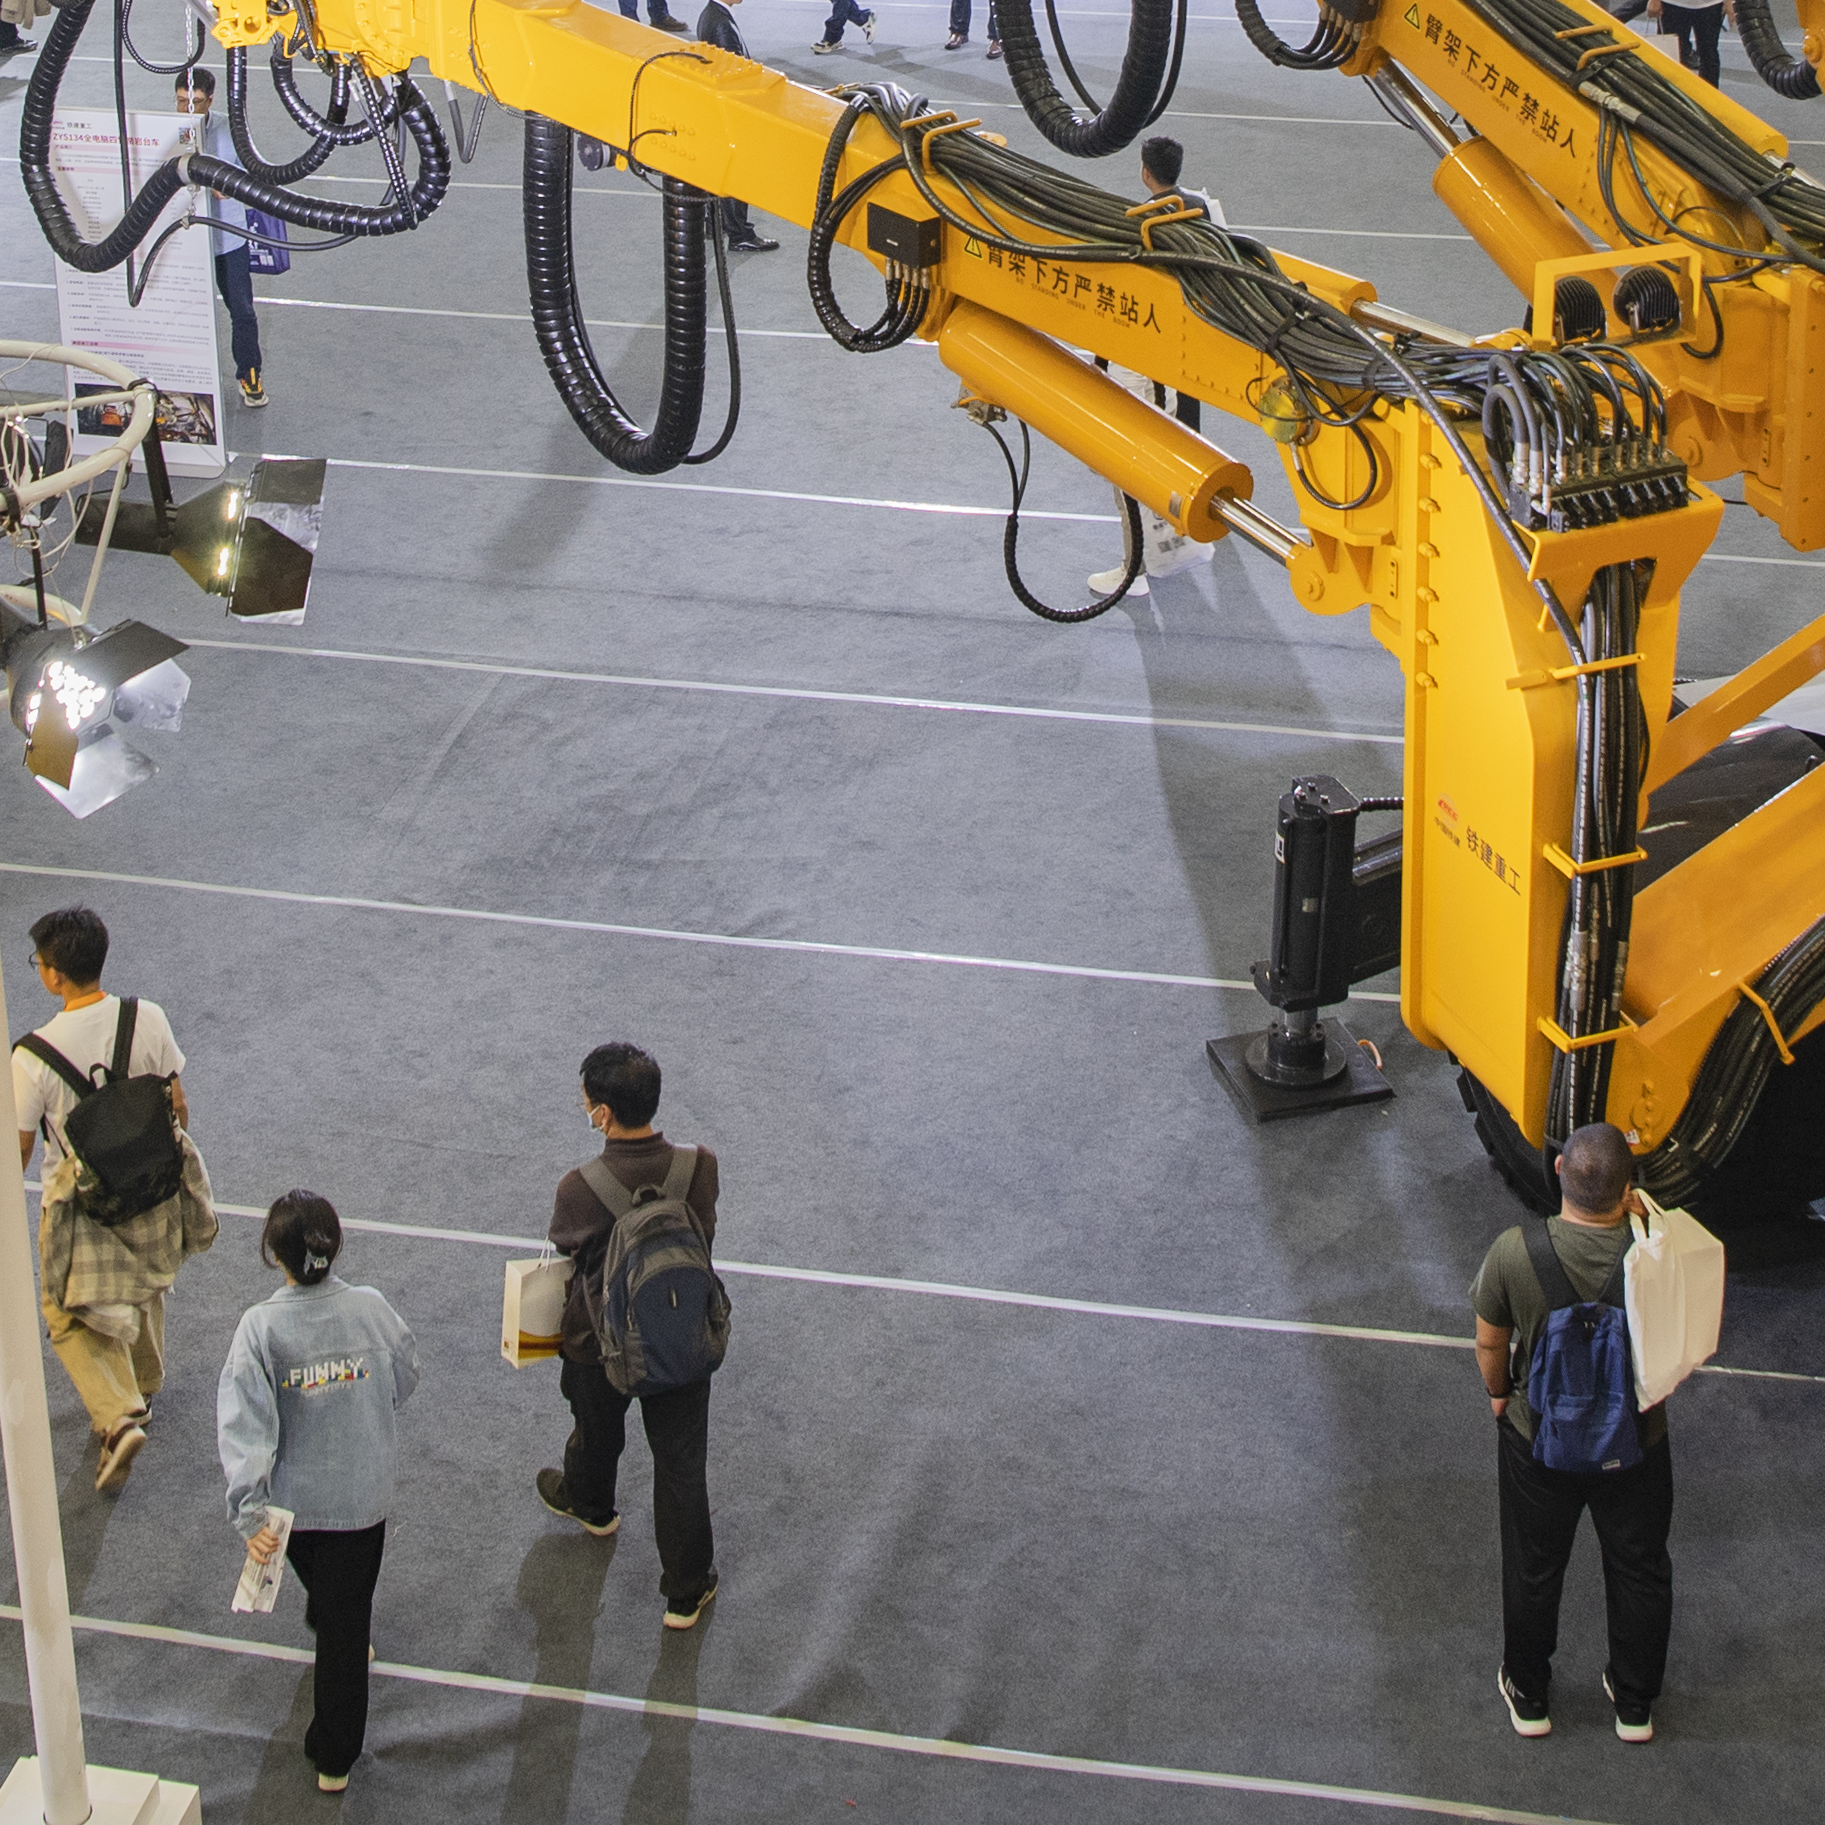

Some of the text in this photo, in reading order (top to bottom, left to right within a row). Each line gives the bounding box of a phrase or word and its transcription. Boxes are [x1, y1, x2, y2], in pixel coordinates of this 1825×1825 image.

[1424, 13, 1579, 159] 臂架下方严禁站人
[986, 244, 1163, 334] 臂架下方严禁站人
[1465, 824, 1521, 897] 铁建重工
[289, 1357, 365, 1386] FUNNY
